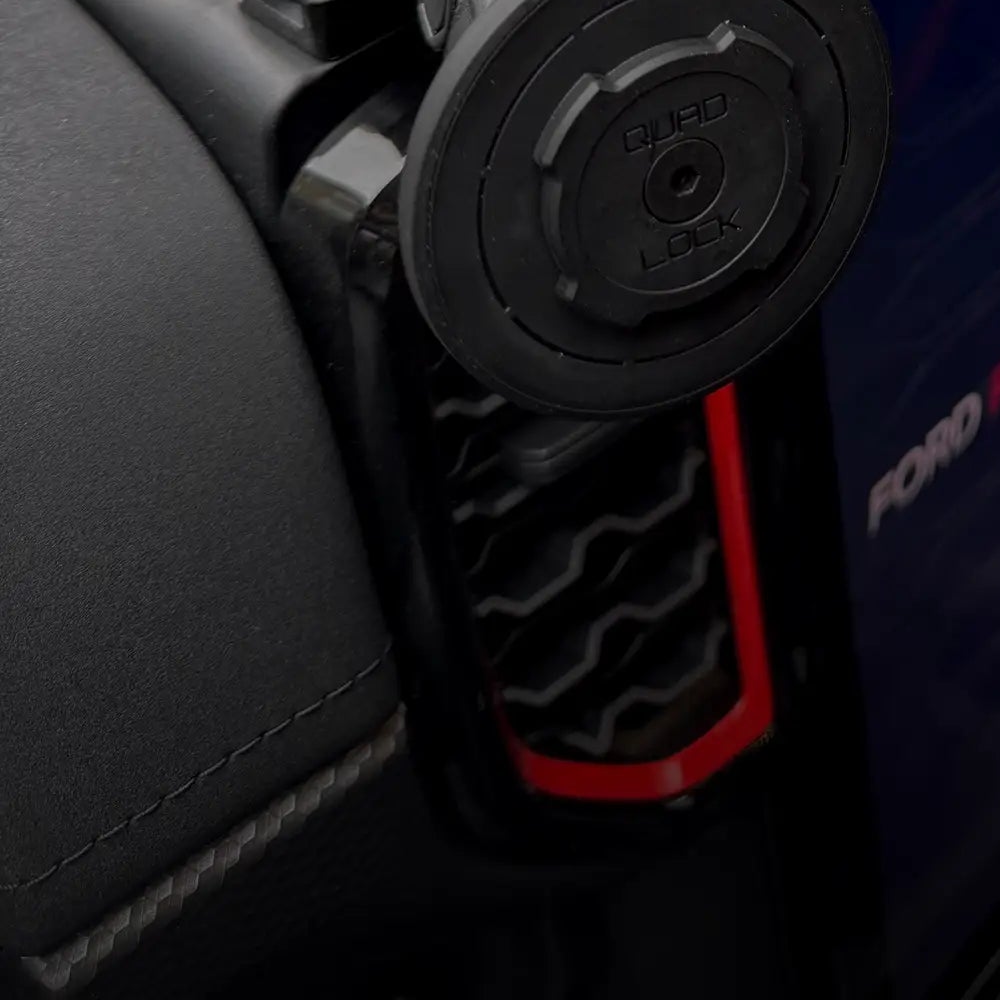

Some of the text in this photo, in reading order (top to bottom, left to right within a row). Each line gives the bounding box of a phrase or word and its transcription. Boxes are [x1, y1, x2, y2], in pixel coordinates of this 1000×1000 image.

[623, 93, 728, 154] QUAD
[640, 206, 743, 271] LOCK
[867, 391, 983, 539] FORD
